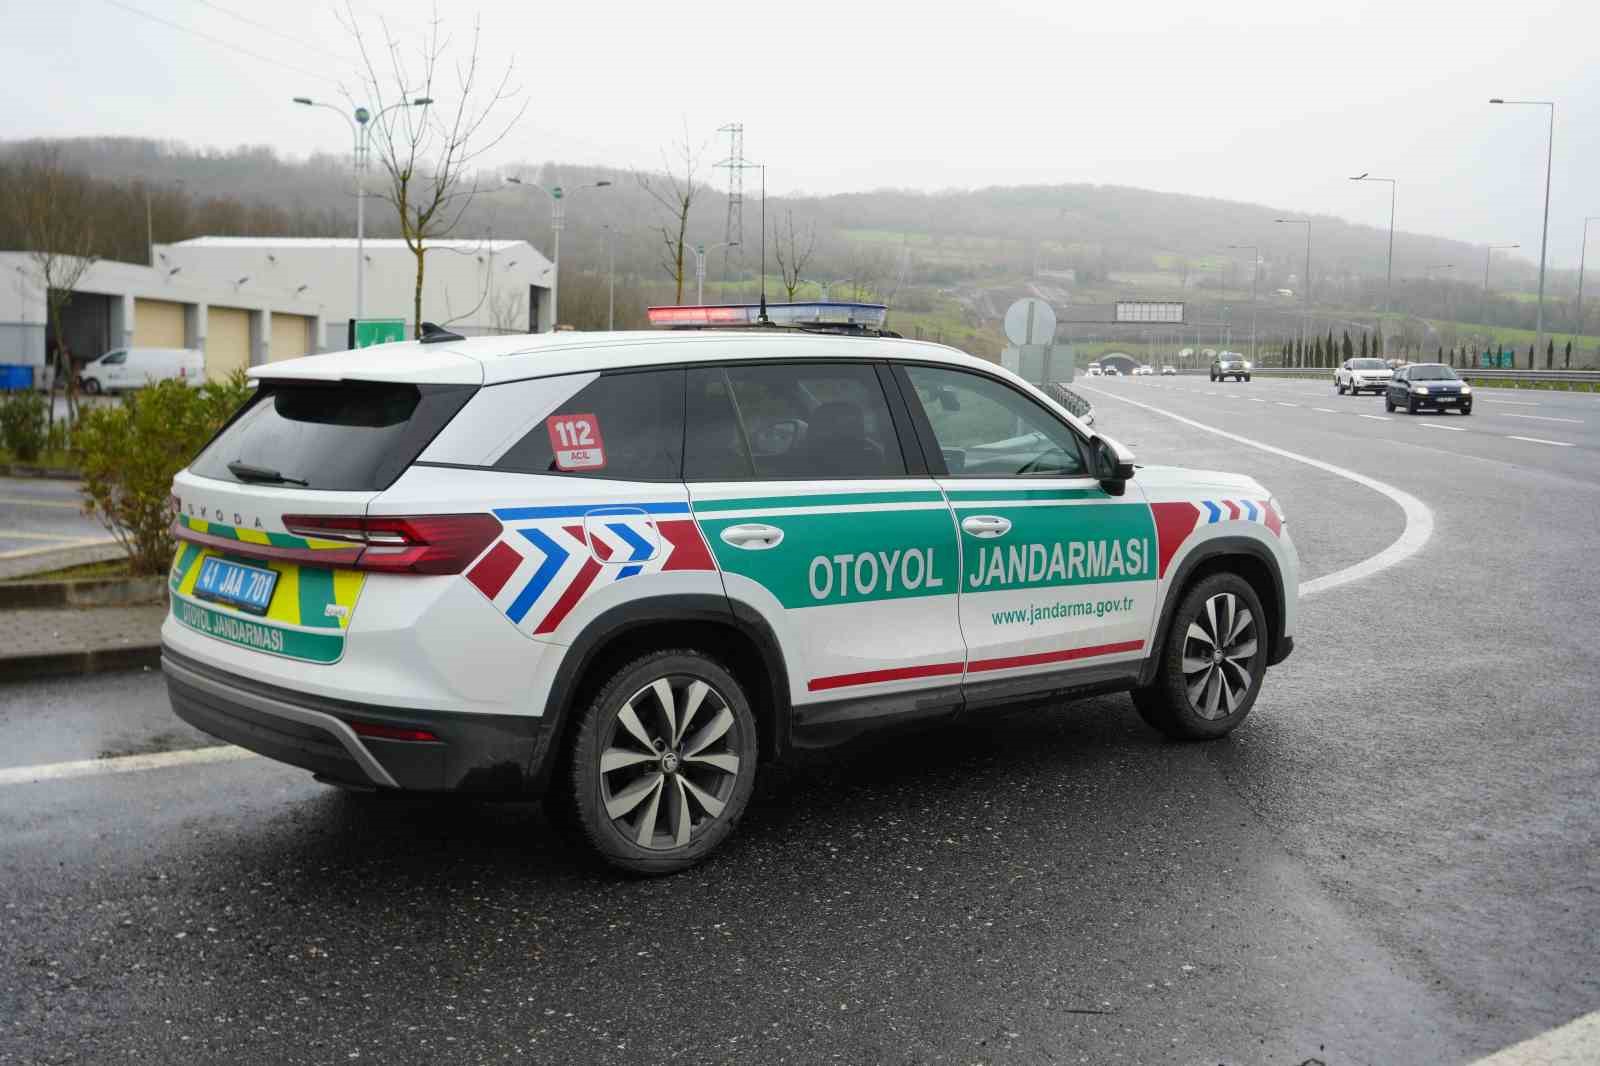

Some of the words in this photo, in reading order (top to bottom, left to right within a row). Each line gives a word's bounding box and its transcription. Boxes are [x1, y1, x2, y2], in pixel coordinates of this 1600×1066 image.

[555, 420, 595, 447] 112
[808, 547, 944, 600] OTOYOL
[969, 537, 1149, 588] JANDARMASI
[245, 571, 273, 603] 701
[991, 597, 1134, 625] www.jandarma.gov.tr
[213, 614, 284, 651] JANDARMASI
